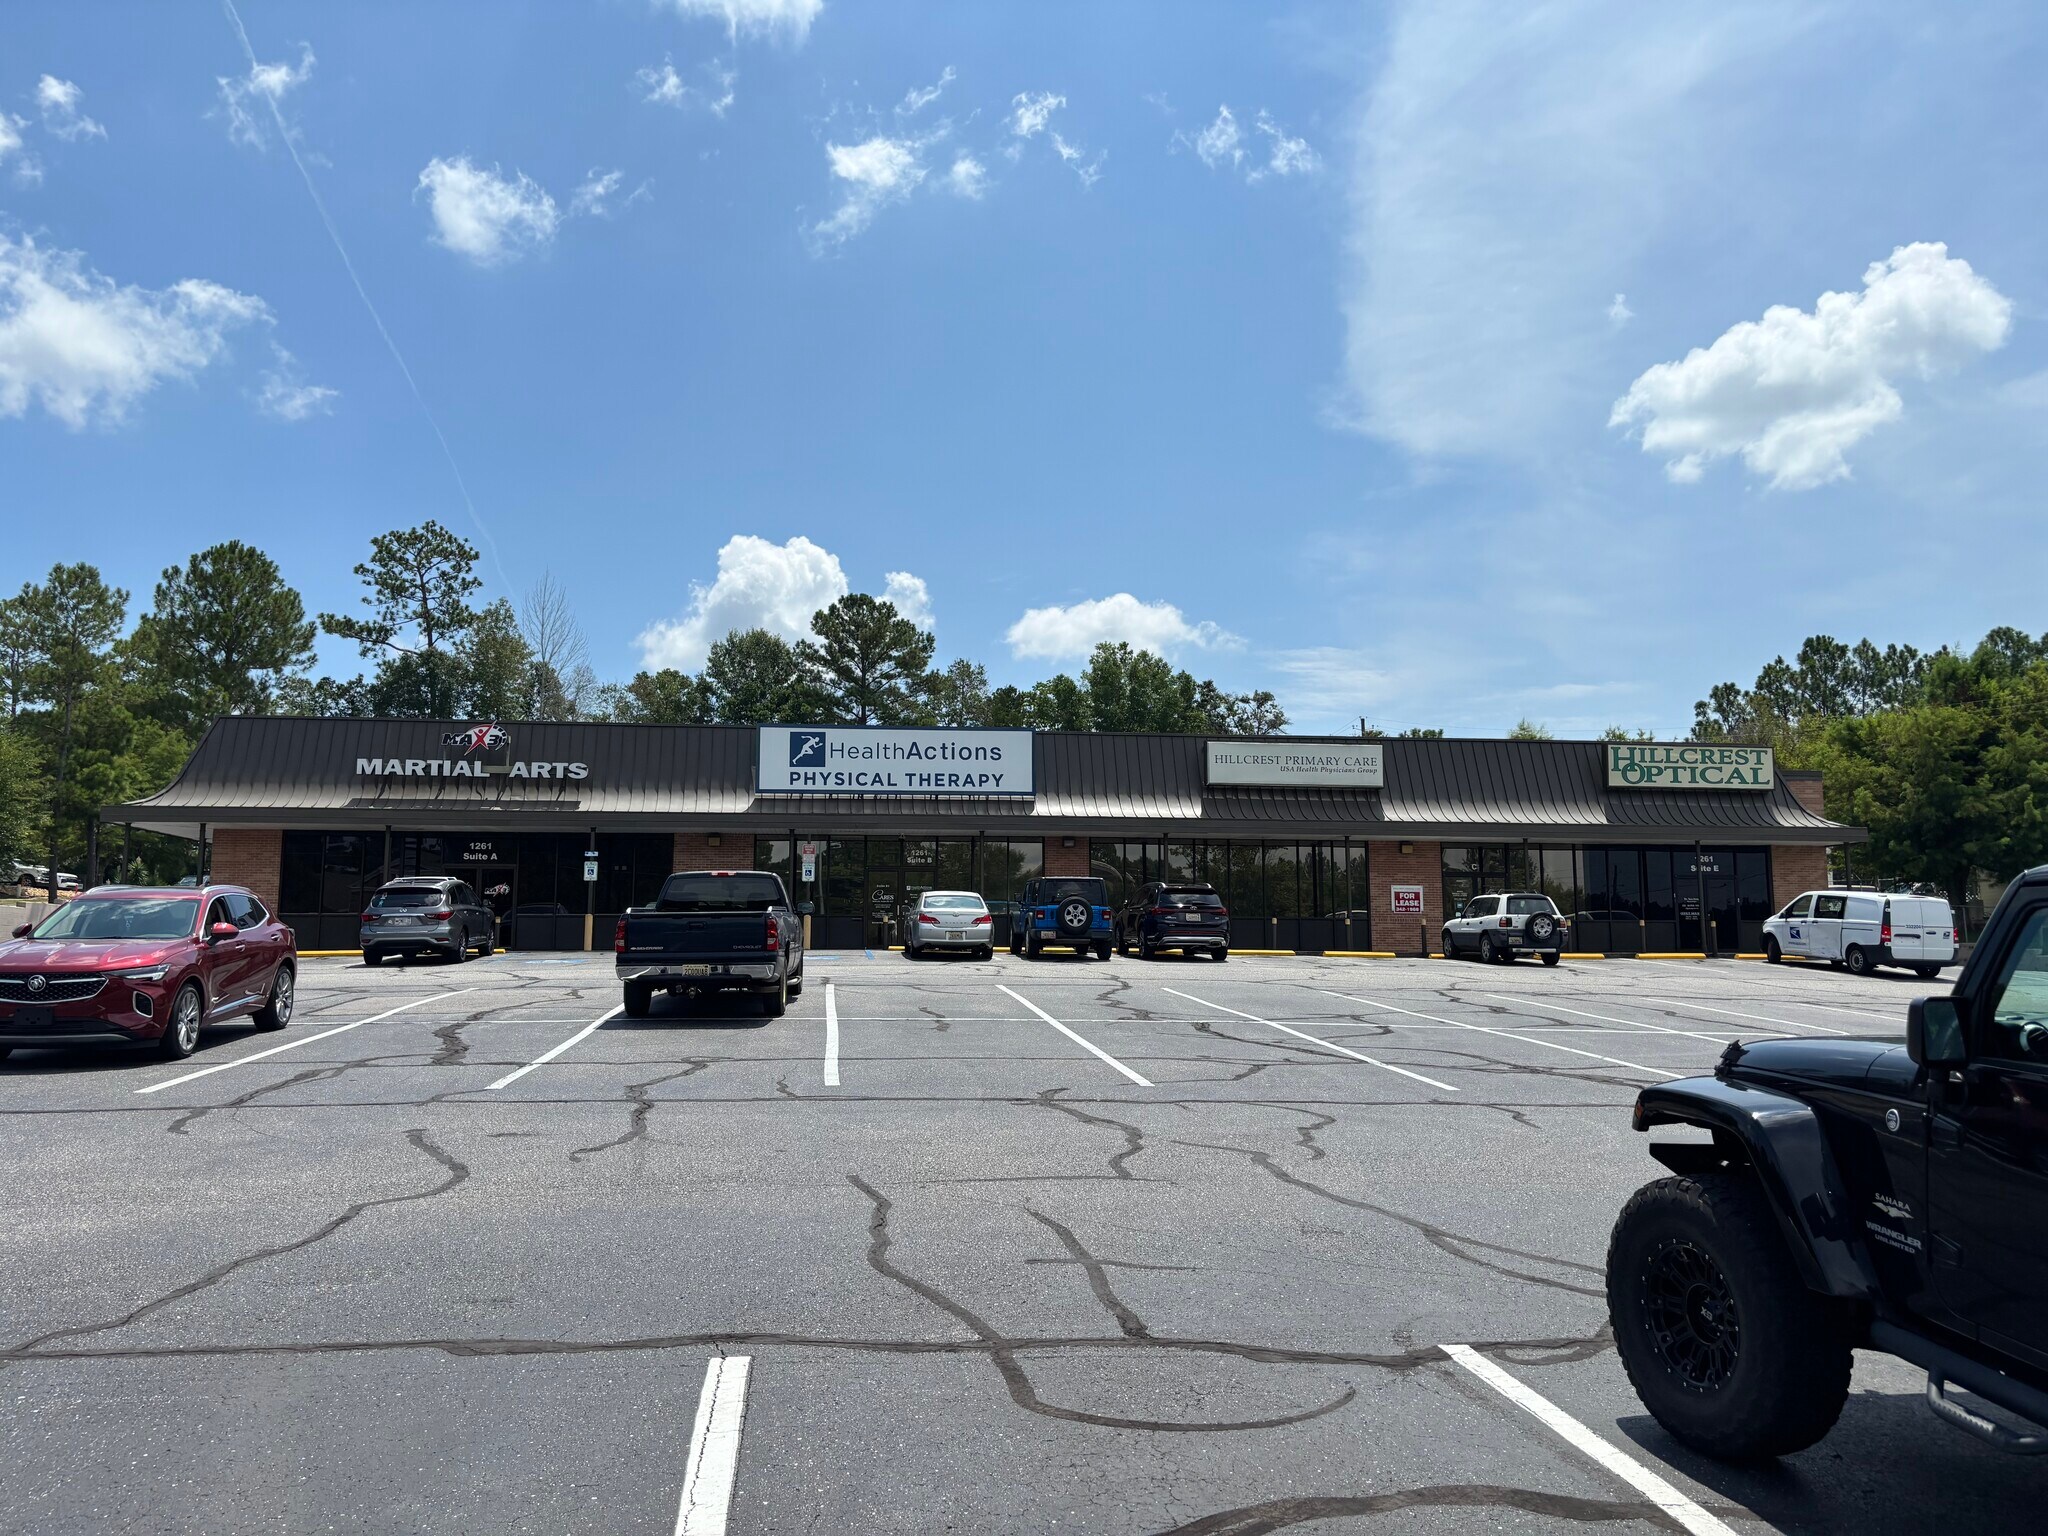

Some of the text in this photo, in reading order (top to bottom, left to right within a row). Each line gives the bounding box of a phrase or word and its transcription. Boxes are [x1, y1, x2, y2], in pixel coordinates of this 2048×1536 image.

[830, 741, 1003, 761] HealthActions
[1610, 746, 1769, 773] HILLCREST
[356, 758, 589, 780] MARTIAL ARTS
[1214, 754, 1378, 767] HILLCREST PRIMARY CARE
[789, 771, 1004, 788] PHYSICAL THERAPY
[1279, 765, 1295, 773] USA
[1320, 766, 1356, 775] Physicians
[1357, 766, 1378, 776] Group
[1621, 762, 1771, 785] OPTICAL
[469, 842, 492, 850] 1261
[463, 852, 488, 860] Suite
[1694, 855, 1714, 863] 261
[1690, 864, 1712, 872] Site
[1874, 1193, 1911, 1212] SAHARA
[1865, 1220, 1922, 1250] WRANGLER
[1874, 1234, 1916, 1254] UNLIMITED
